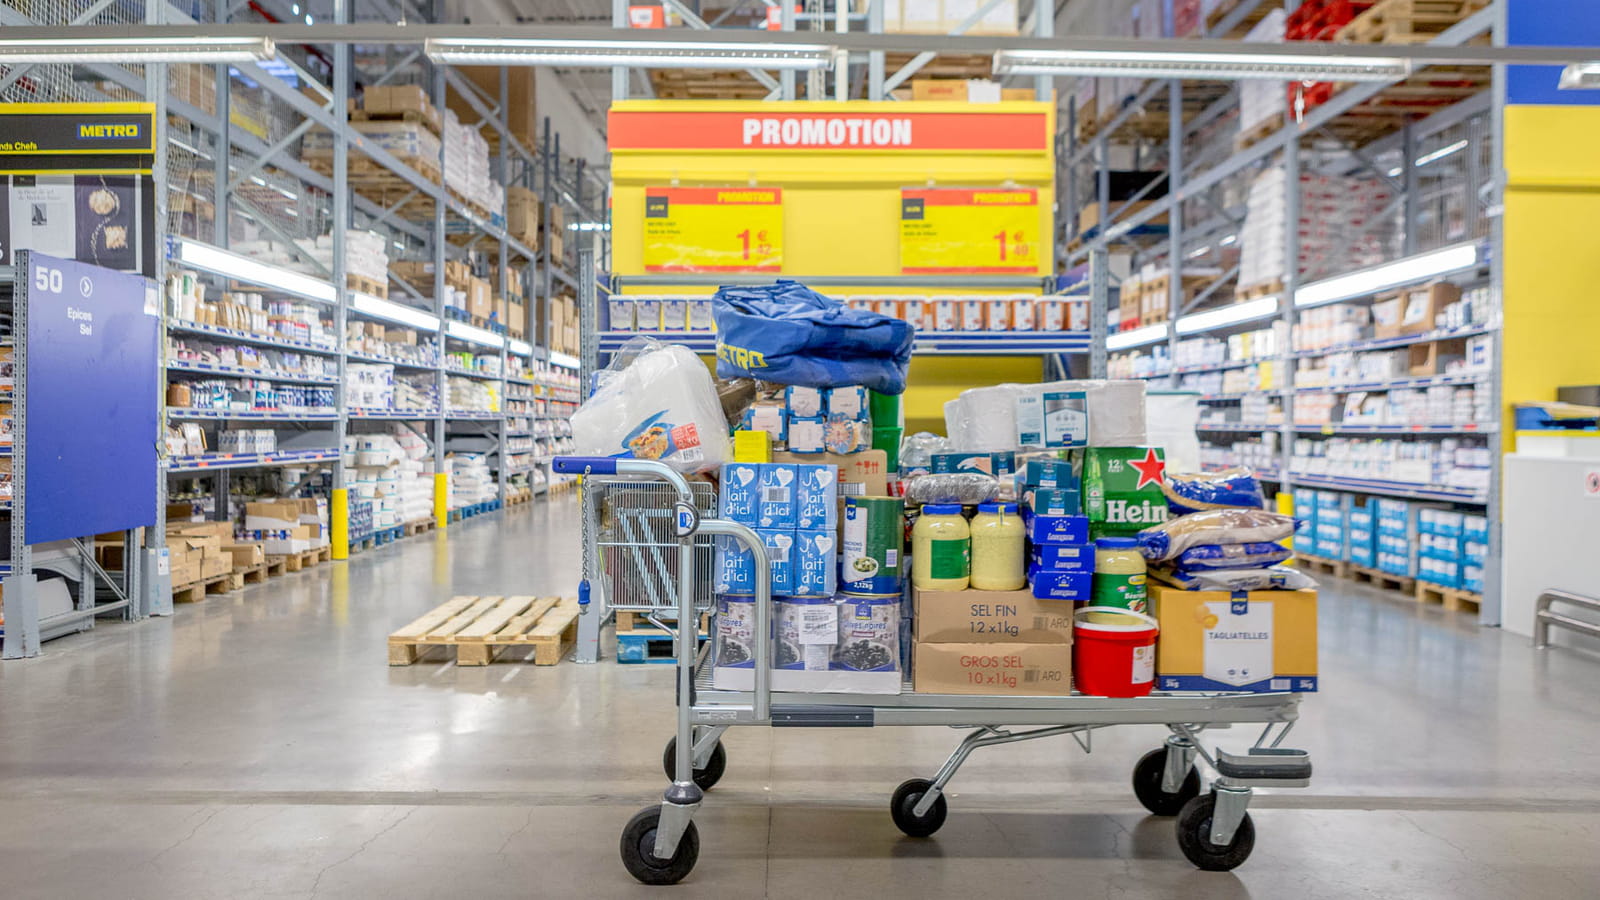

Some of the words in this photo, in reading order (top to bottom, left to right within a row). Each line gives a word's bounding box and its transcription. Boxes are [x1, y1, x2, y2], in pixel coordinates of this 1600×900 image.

[80, 124, 138, 137] METRO
[742, 118, 912, 145] PROMOTION
[14, 141, 38, 150] Chefs
[717, 191, 775, 203] PROMOTION
[972, 192, 1031, 203] PROMOTION
[736, 229, 750, 261] 1
[993, 230, 1006, 262] 1
[35, 265, 63, 294] 50
[67, 307, 93, 321] Epices
[80, 323, 93, 336] Sel
[727, 488, 749, 502] lait
[806, 489, 826, 503] lait
[725, 502, 750, 515] d'ici
[764, 503, 789, 516] d'ici
[803, 504, 828, 517] d'ici
[722, 552, 744, 568] lait
[801, 556, 824, 570] lait
[722, 569, 748, 582] d'ici
[773, 570, 787, 583] ici
[801, 571, 827, 584] d'ici
[853, 582, 874, 590] 2,12kg
[970, 604, 993, 617] SEL
[995, 604, 1017, 617] FIN
[969, 621, 984, 633] 12
[988, 621, 1019, 636] x1kg
[1050, 617, 1069, 628] ARO
[1208, 632, 1268, 640] TAGLIATELLES
[959, 655, 999, 668] GROS
[1002, 655, 1024, 668] SEL
[968, 671, 983, 684] 10
[986, 671, 1017, 687] x1kg
[1041, 671, 1062, 681] ARO
